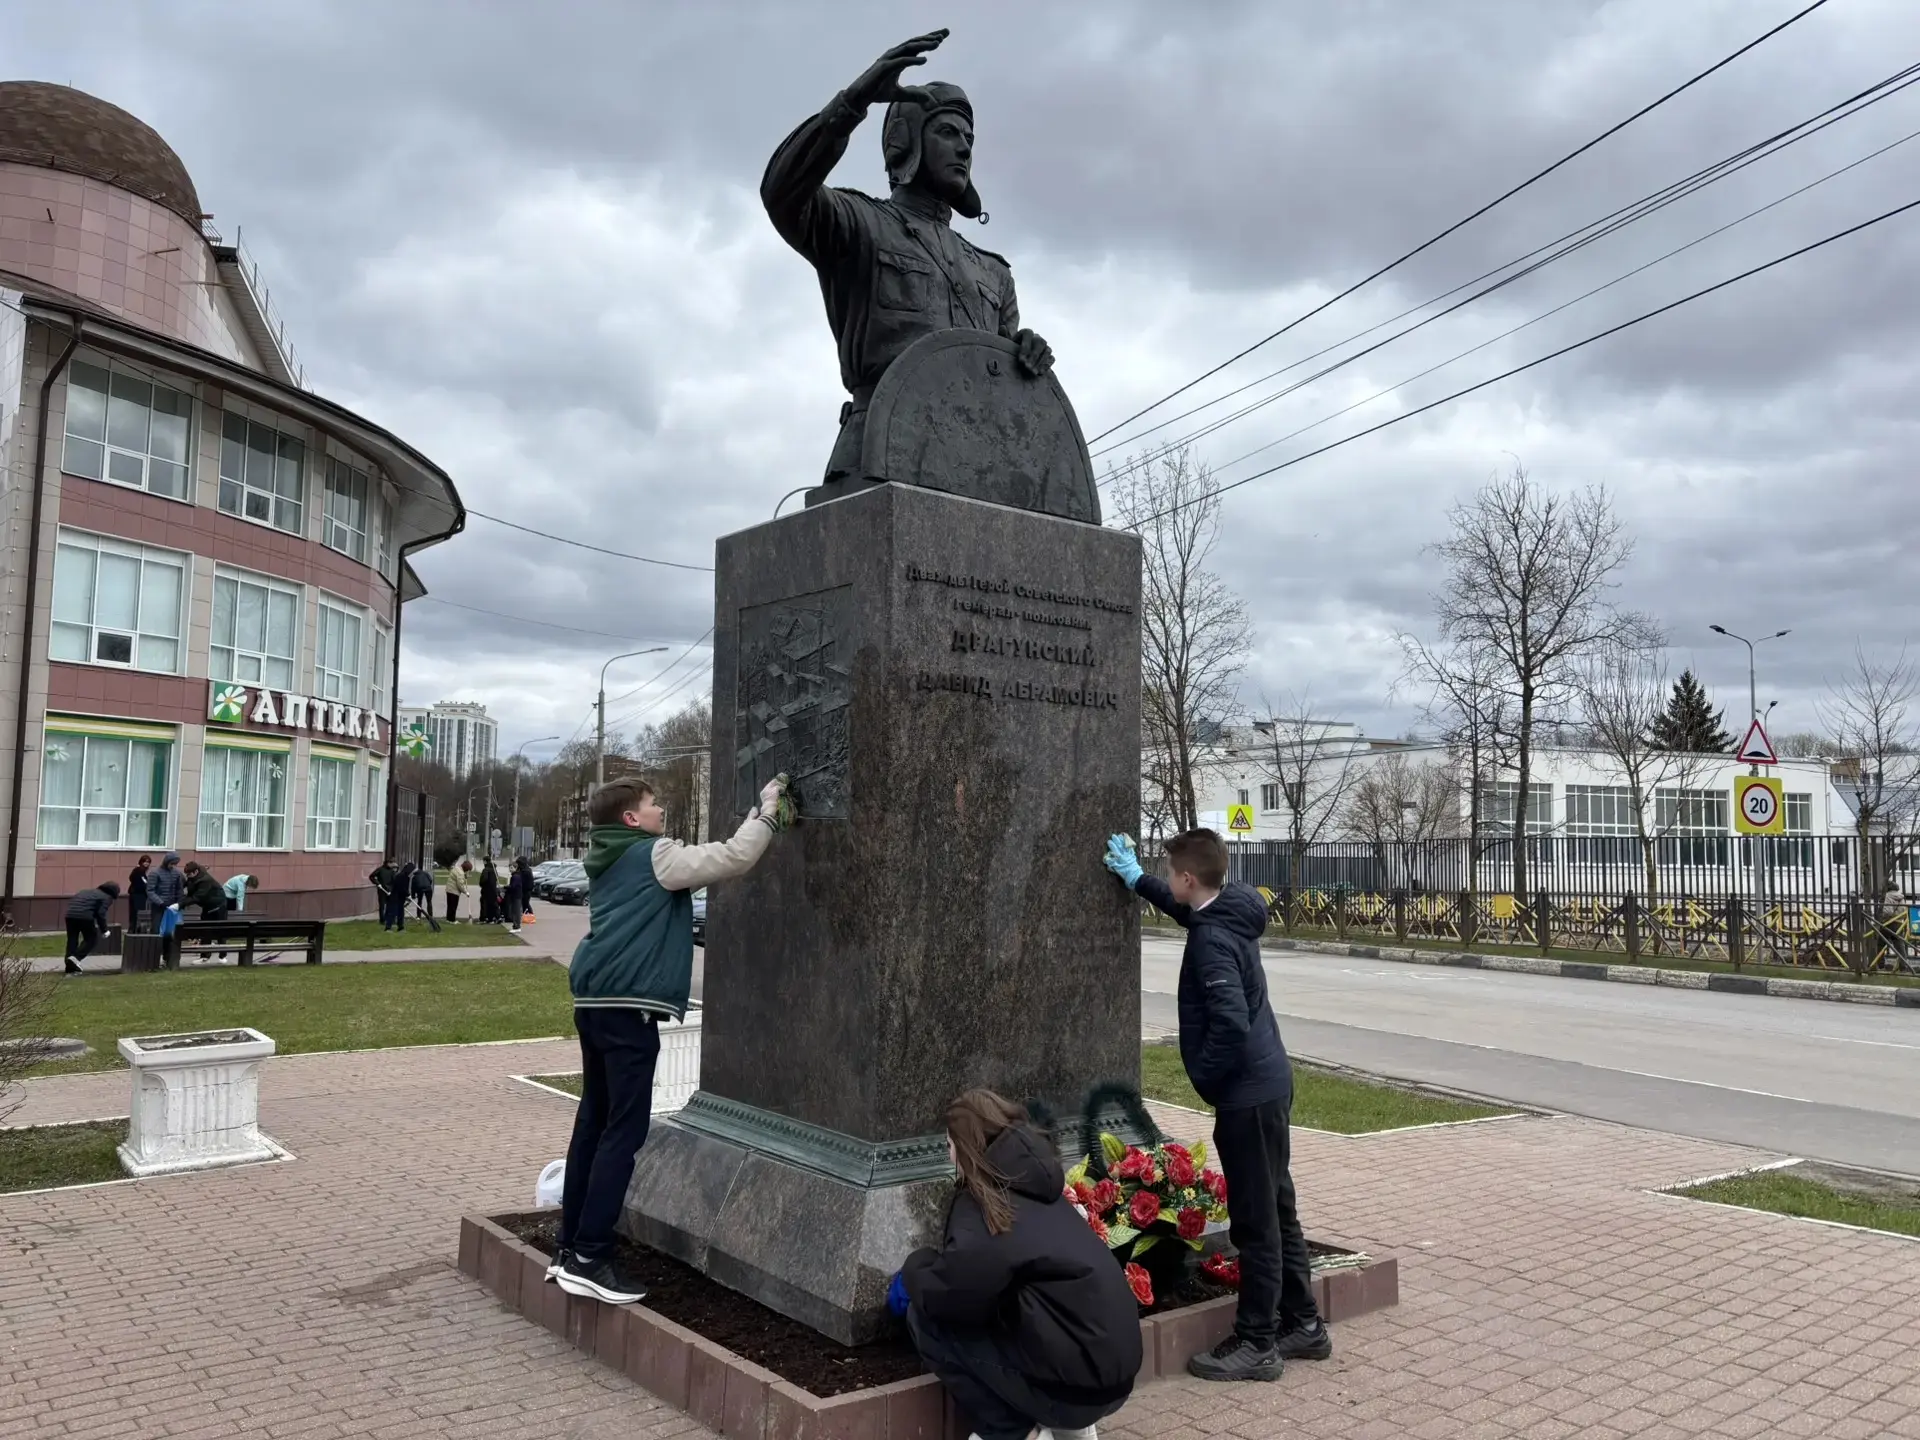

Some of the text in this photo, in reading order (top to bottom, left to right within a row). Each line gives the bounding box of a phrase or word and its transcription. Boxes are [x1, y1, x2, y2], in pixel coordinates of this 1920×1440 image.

[916, 669, 1119, 711] ДАВИД АБРАМОВИЧ
[251, 690, 380, 740] АПТЕКА
[1749, 797, 1769, 814] 20
